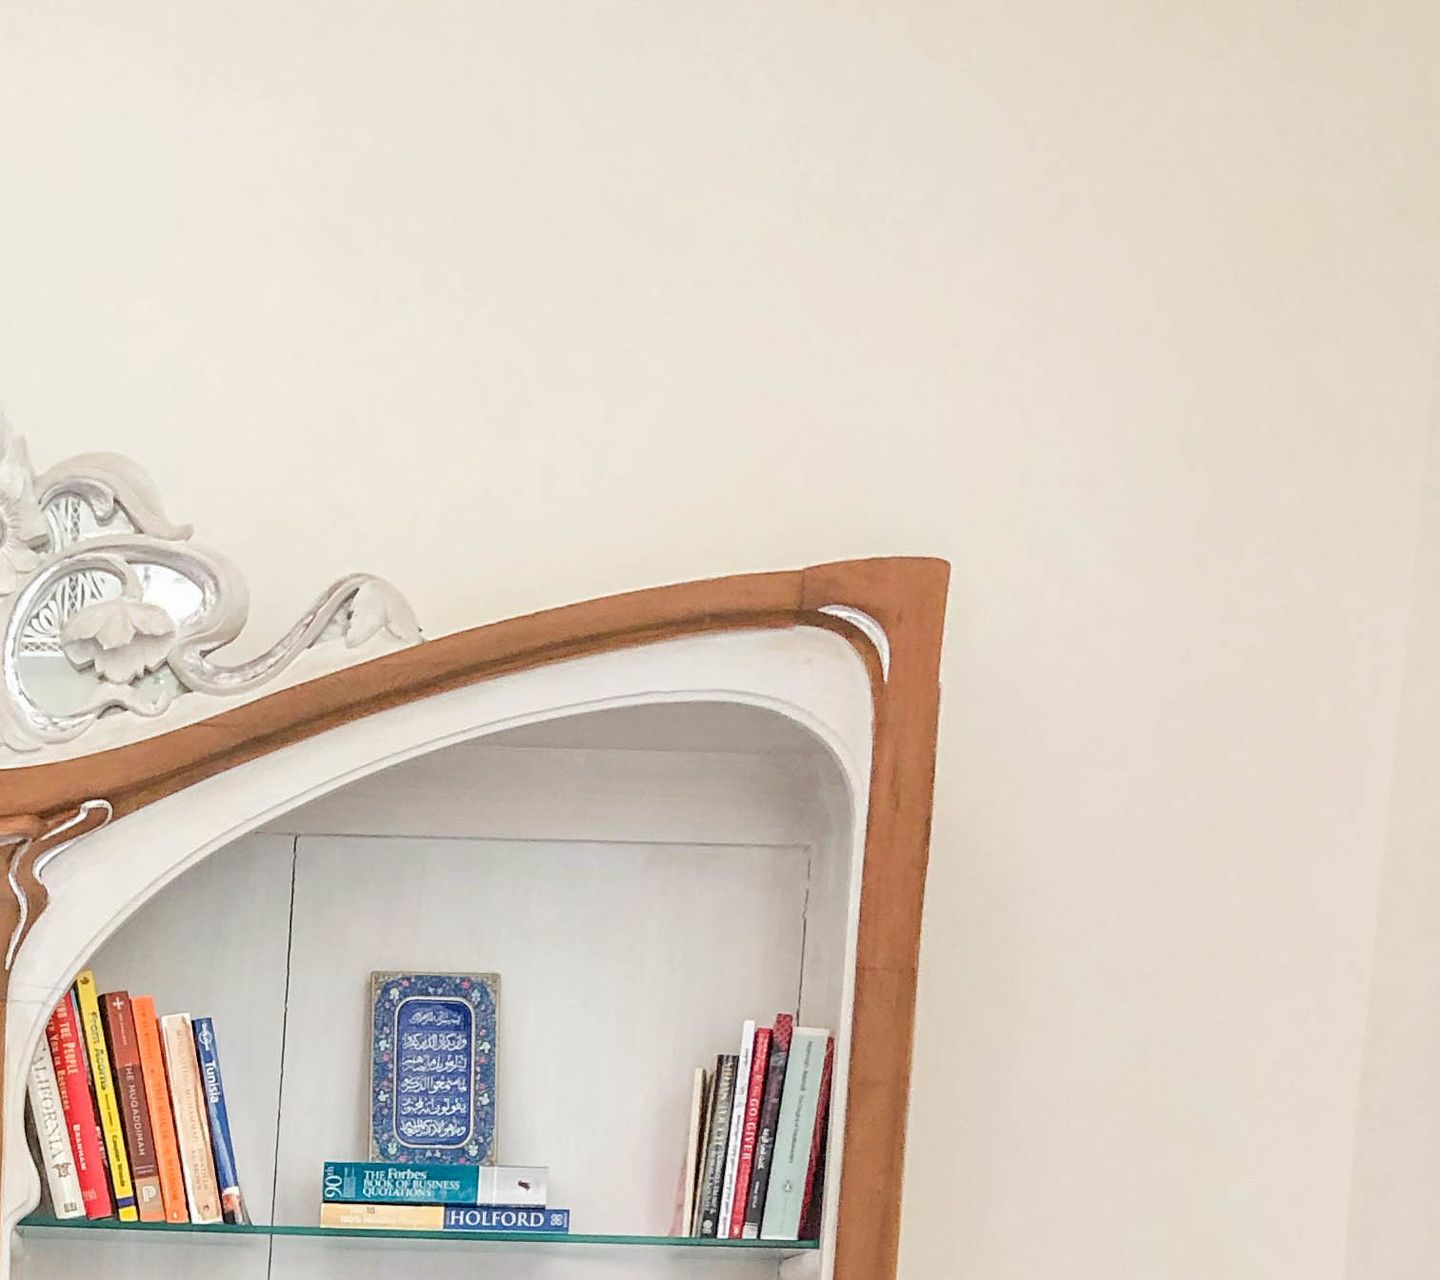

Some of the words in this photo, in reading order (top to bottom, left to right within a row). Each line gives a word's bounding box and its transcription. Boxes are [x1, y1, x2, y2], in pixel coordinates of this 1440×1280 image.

[93, 1046, 110, 1090] Acorns
[124, 1061, 134, 1081] THE
[203, 1059, 221, 1103] Tunisia
[127, 1083, 145, 1155] MUQADDIMAH
[71, 1123, 86, 1170] BRANHAM
[363, 1171, 386, 1181] THE
[387, 1168, 427, 1180] Forbes
[363, 1179, 393, 1189] BOOK
[395, 1179, 409, 1189] OF
[413, 1180, 460, 1190] BUSINESS
[450, 1210, 545, 1227] HOLFORD
